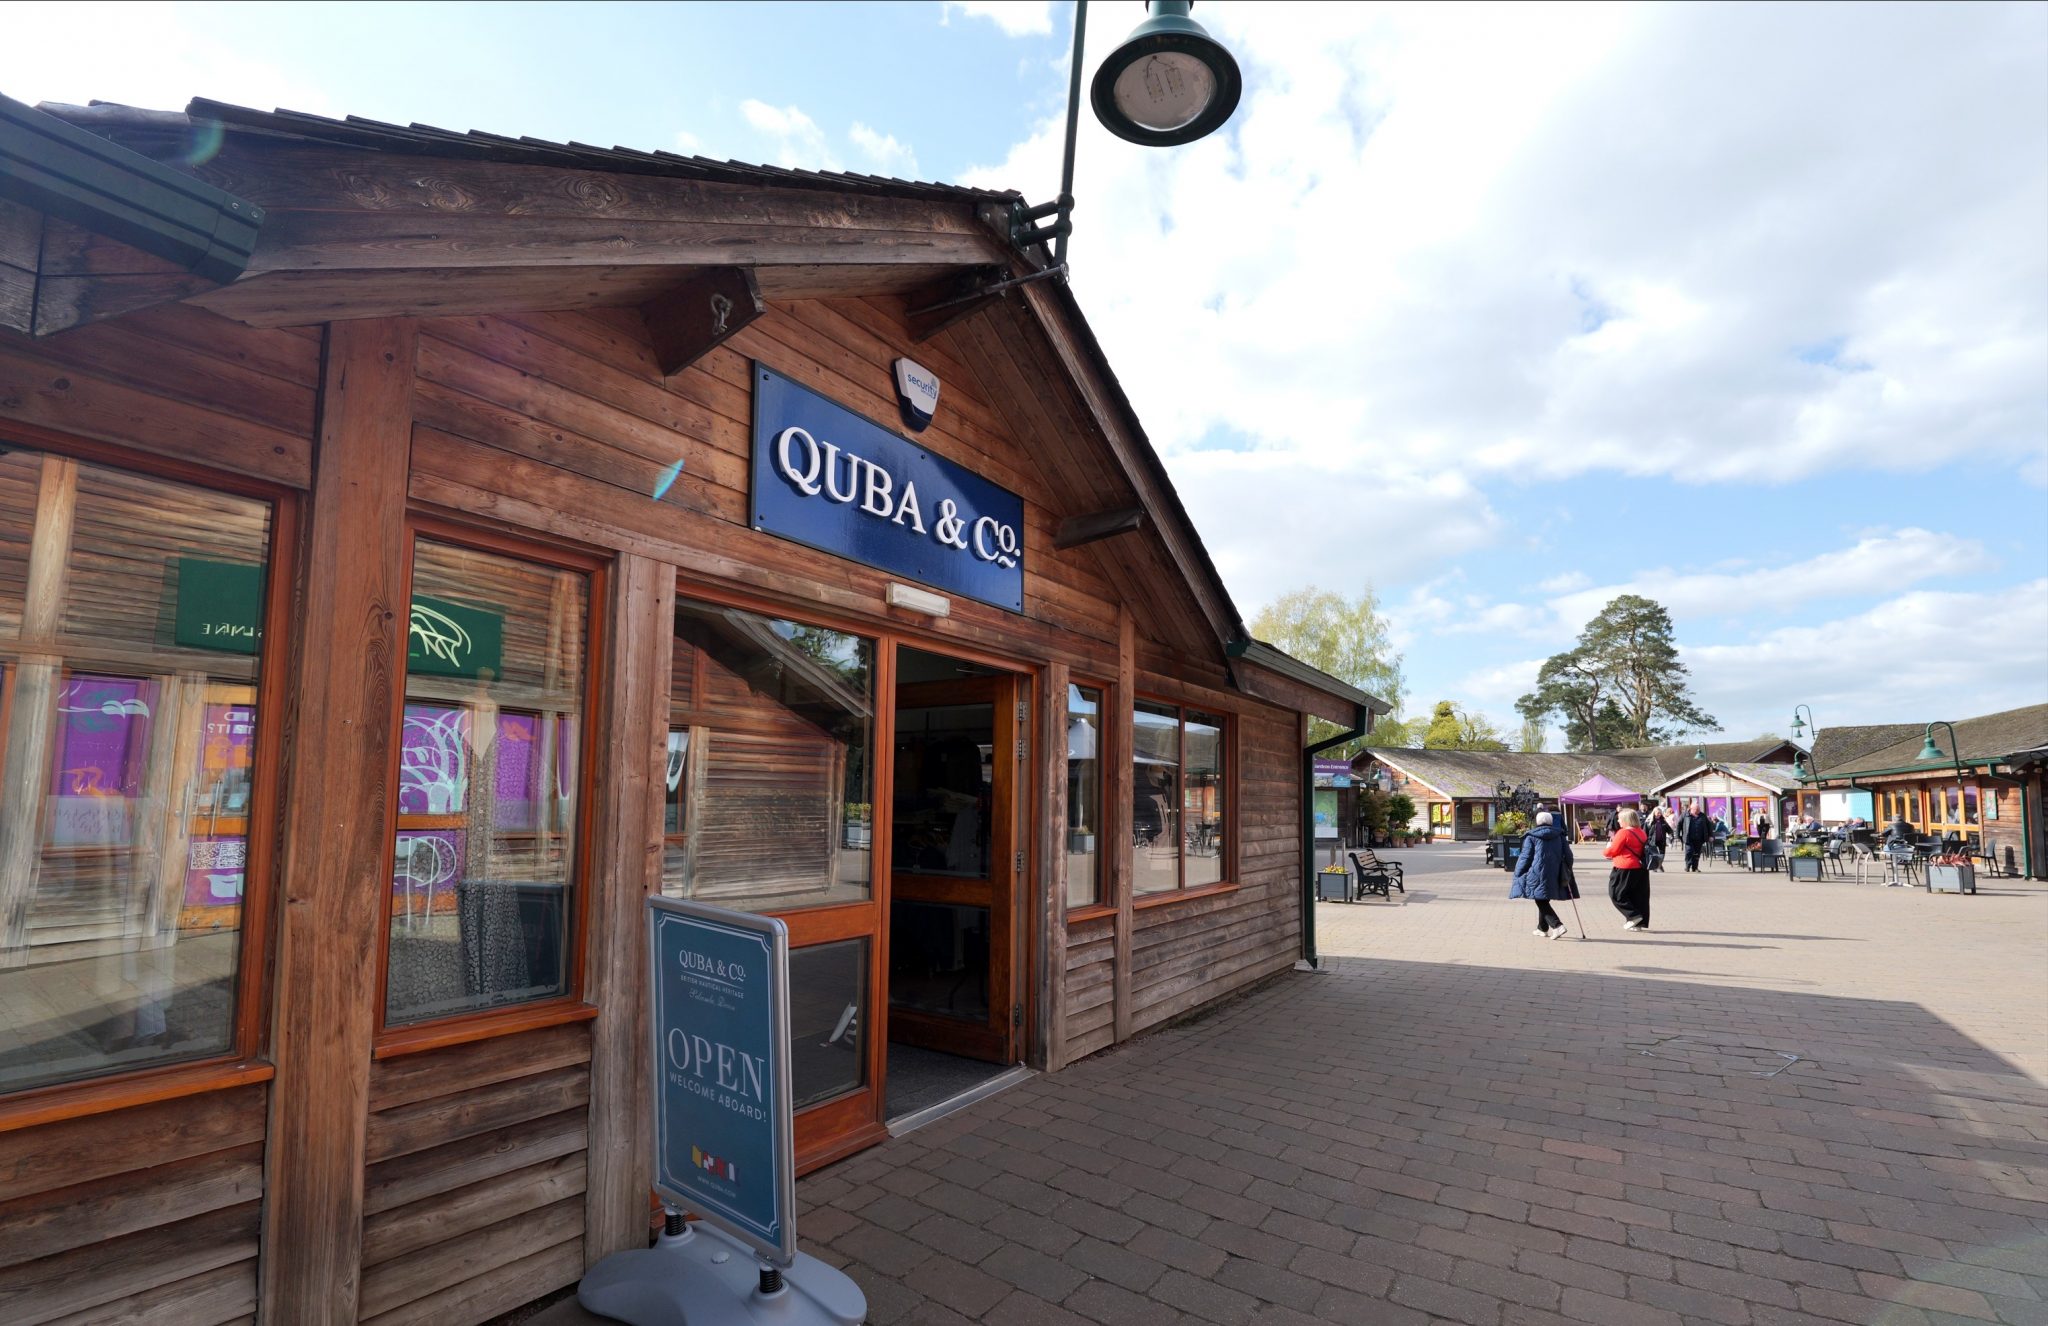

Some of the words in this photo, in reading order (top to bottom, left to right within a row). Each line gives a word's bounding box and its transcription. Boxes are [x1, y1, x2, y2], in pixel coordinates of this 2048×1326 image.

[907, 373, 937, 399] security
[778, 426, 926, 535] QUBA
[935, 498, 967, 550] &
[679, 949, 714, 973] QUBA
[717, 959, 727, 977] &
[668, 1028, 765, 1103] OPEN
[669, 1071, 715, 1101] WELCOME
[718, 1093, 767, 1123] ABOARD!
